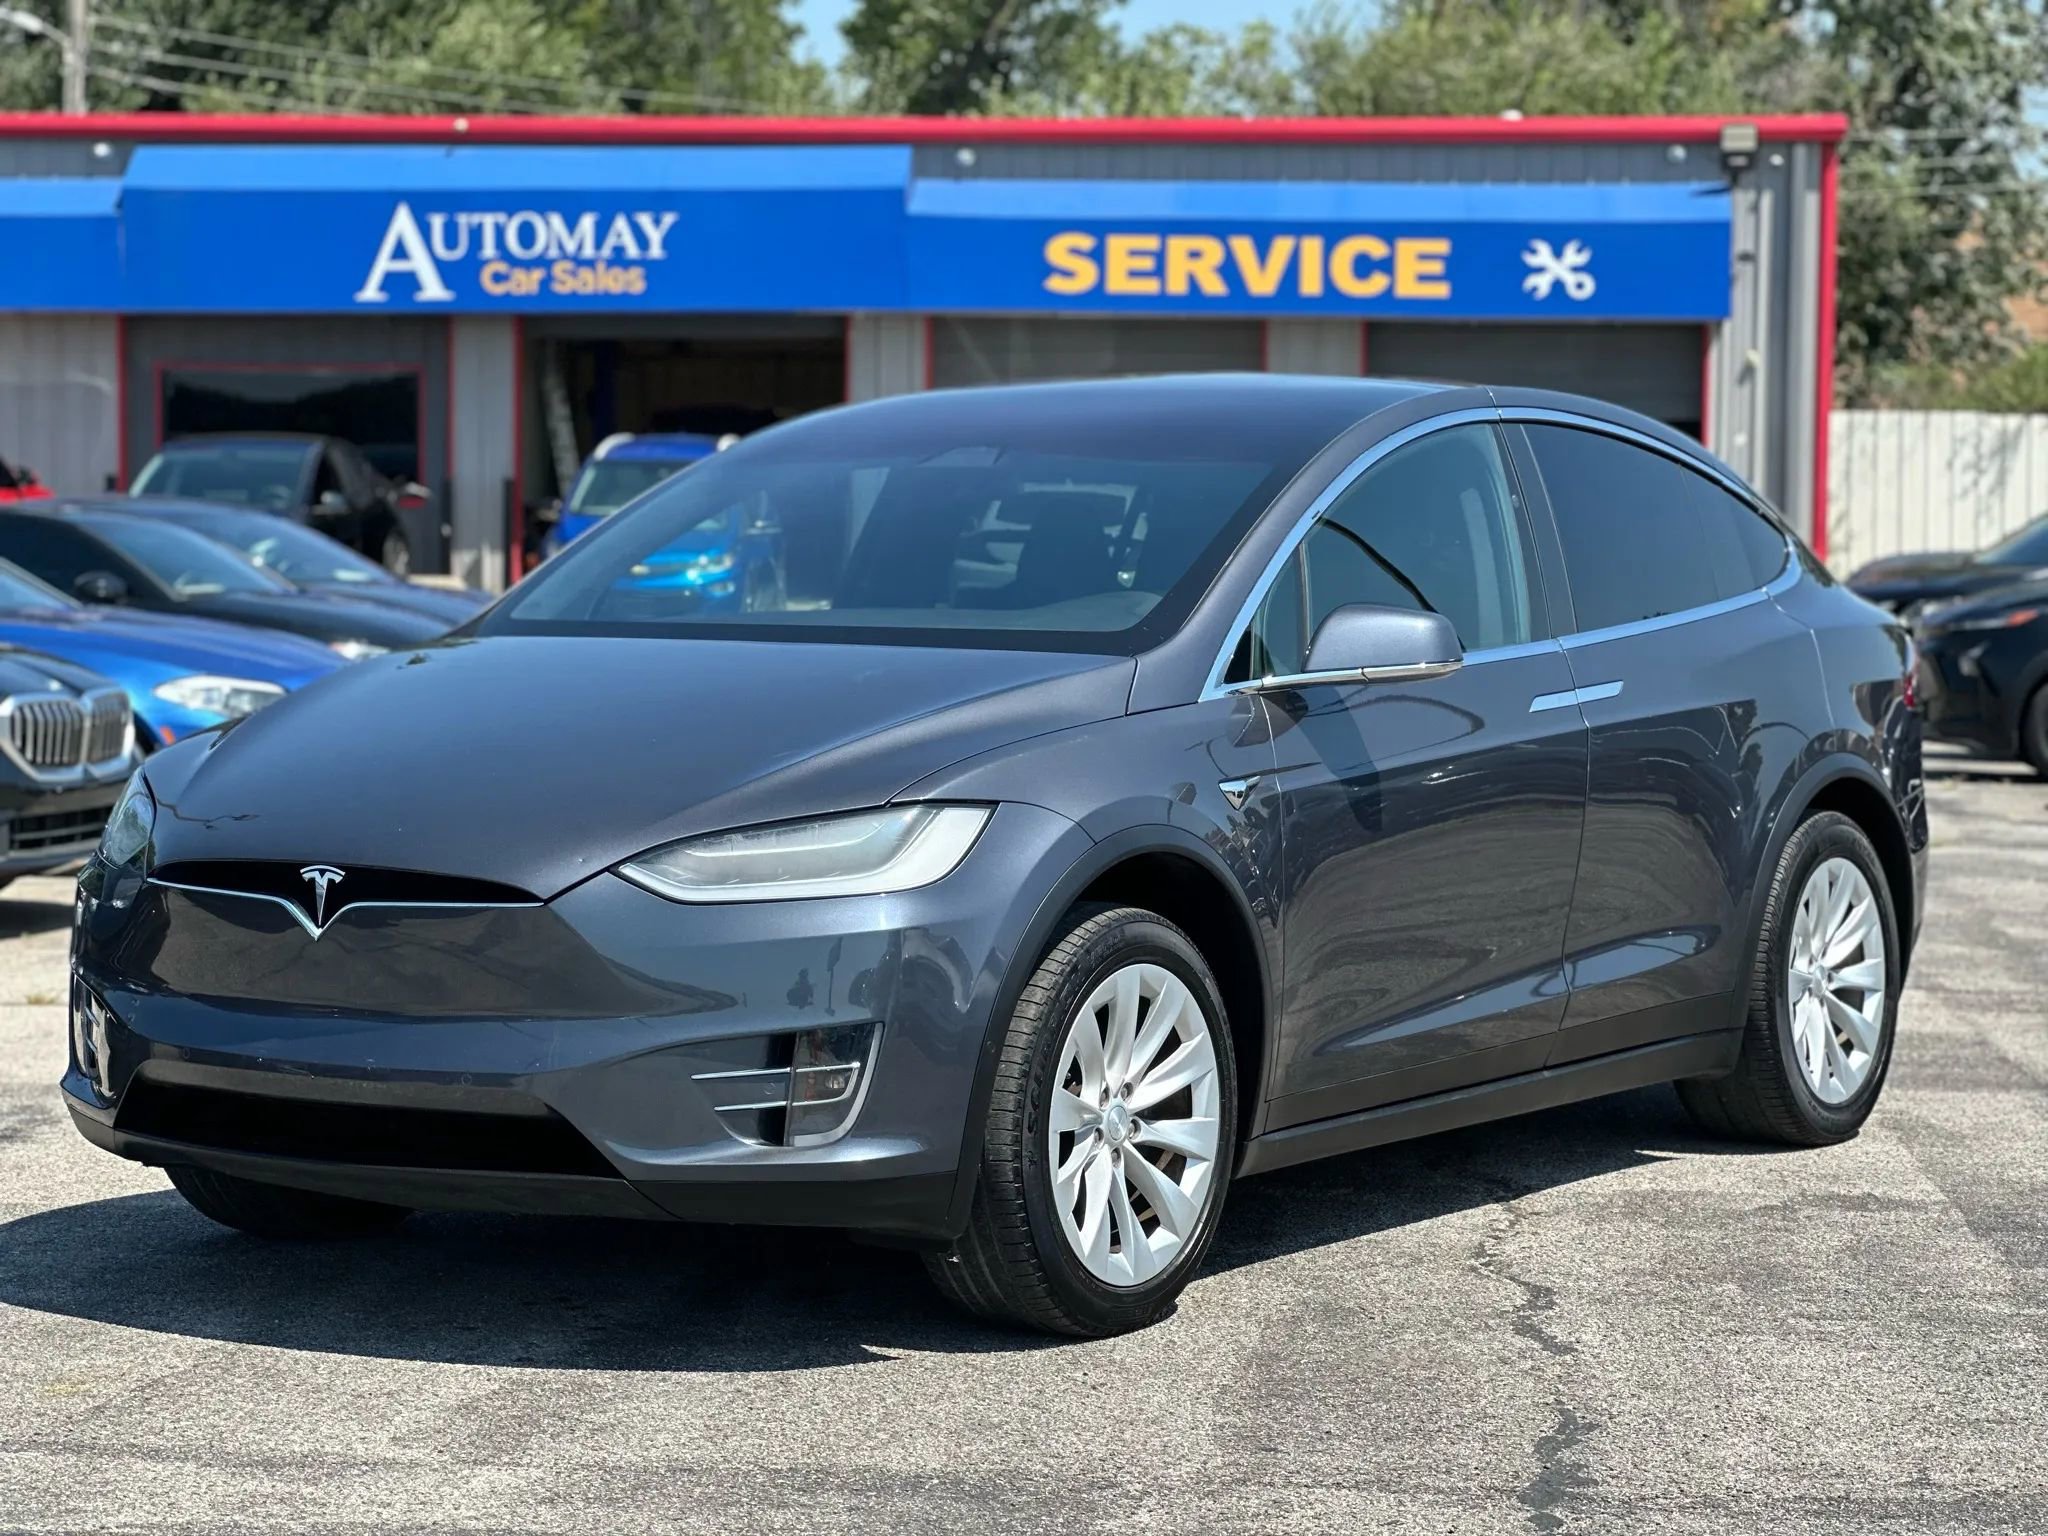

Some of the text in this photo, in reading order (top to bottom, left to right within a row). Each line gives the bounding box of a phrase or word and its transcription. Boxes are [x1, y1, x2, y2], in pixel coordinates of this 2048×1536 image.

[354, 201, 679, 302] AUTOMAY
[480, 260, 647, 295] Car Sales
[1043, 232, 1452, 299] SERVICE
